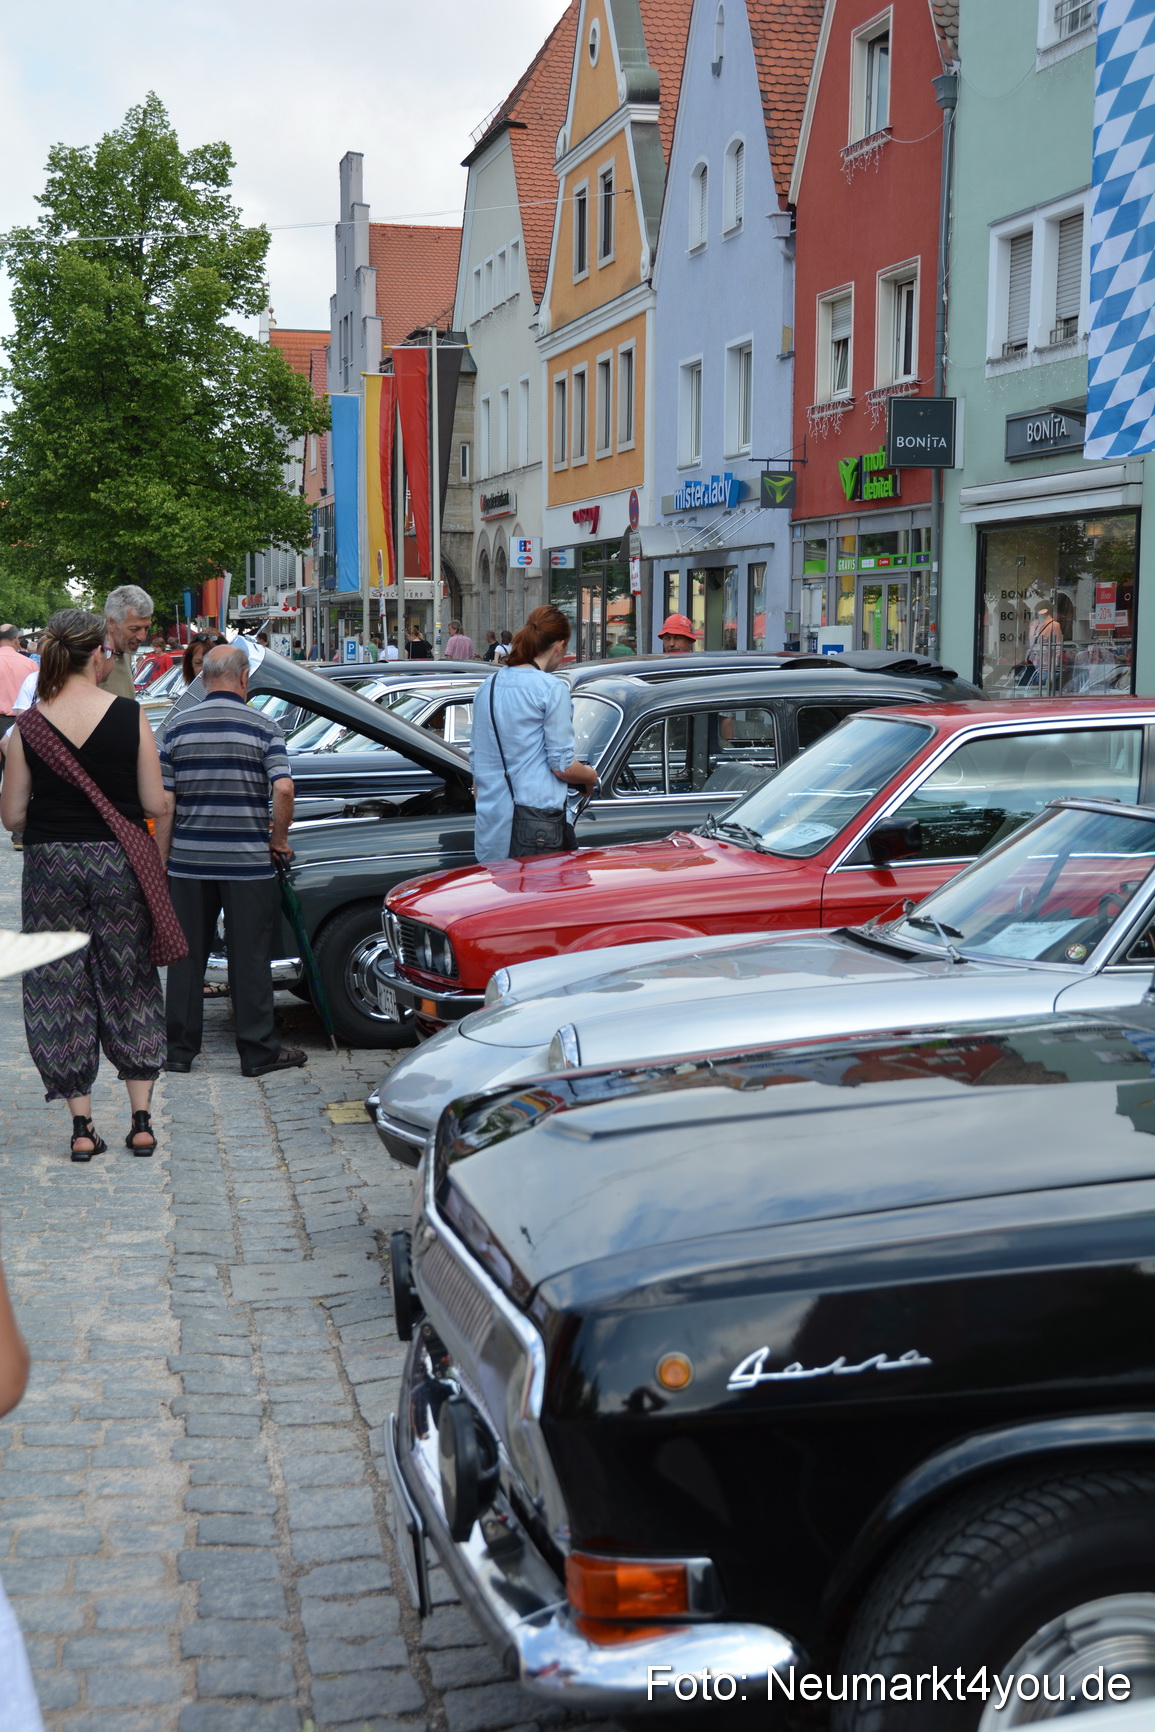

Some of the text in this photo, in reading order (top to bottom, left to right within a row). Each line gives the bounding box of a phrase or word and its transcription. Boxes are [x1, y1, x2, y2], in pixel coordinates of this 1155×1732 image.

[896, 434, 947, 451] BONITA
[863, 474, 893, 500] debitel
[838, 558, 855, 571] GRAVIS
[349, 644, 355, 652] P
